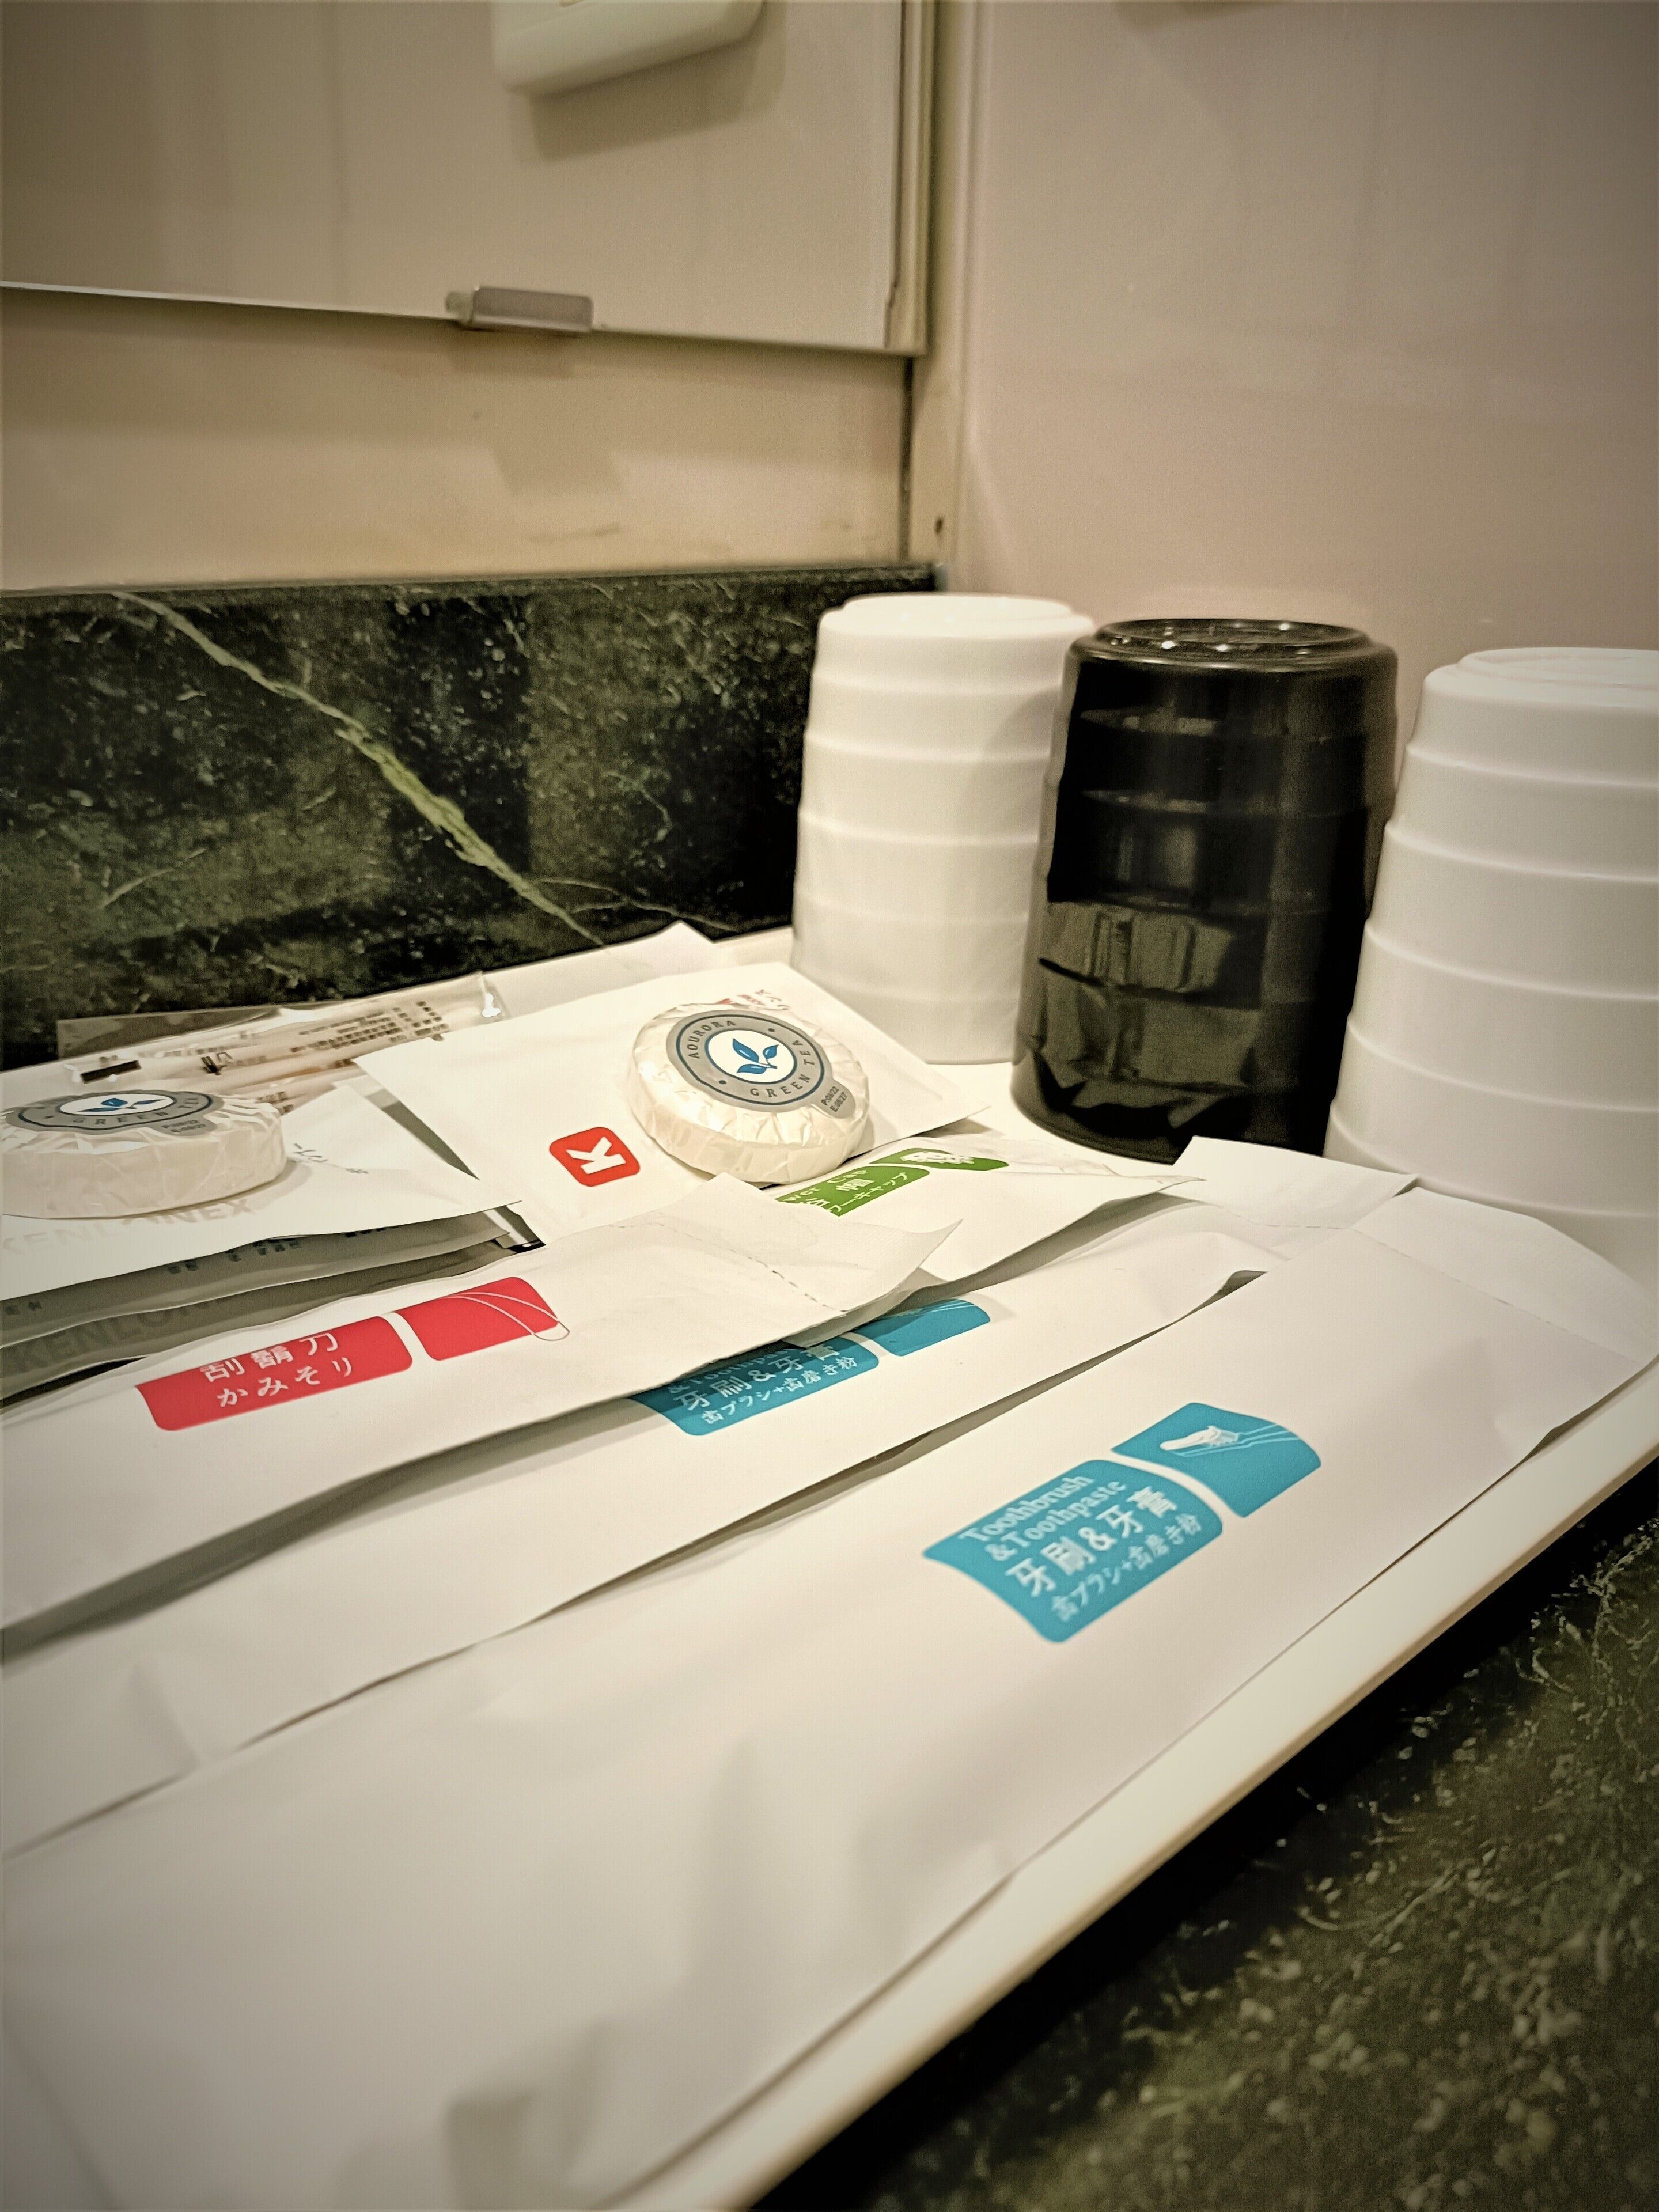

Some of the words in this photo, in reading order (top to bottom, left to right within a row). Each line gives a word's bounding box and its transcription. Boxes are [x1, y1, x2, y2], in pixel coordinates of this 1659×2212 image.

[686, 1020, 737, 1060] AOURORA
[749, 1073, 811, 1098] GREEN
[792, 1040, 815, 1066] TEA
[827, 1169, 868, 1183] Cap
[216, 1357, 353, 1407] かみそり
[957, 1475, 1094, 1543] Toothbrush
